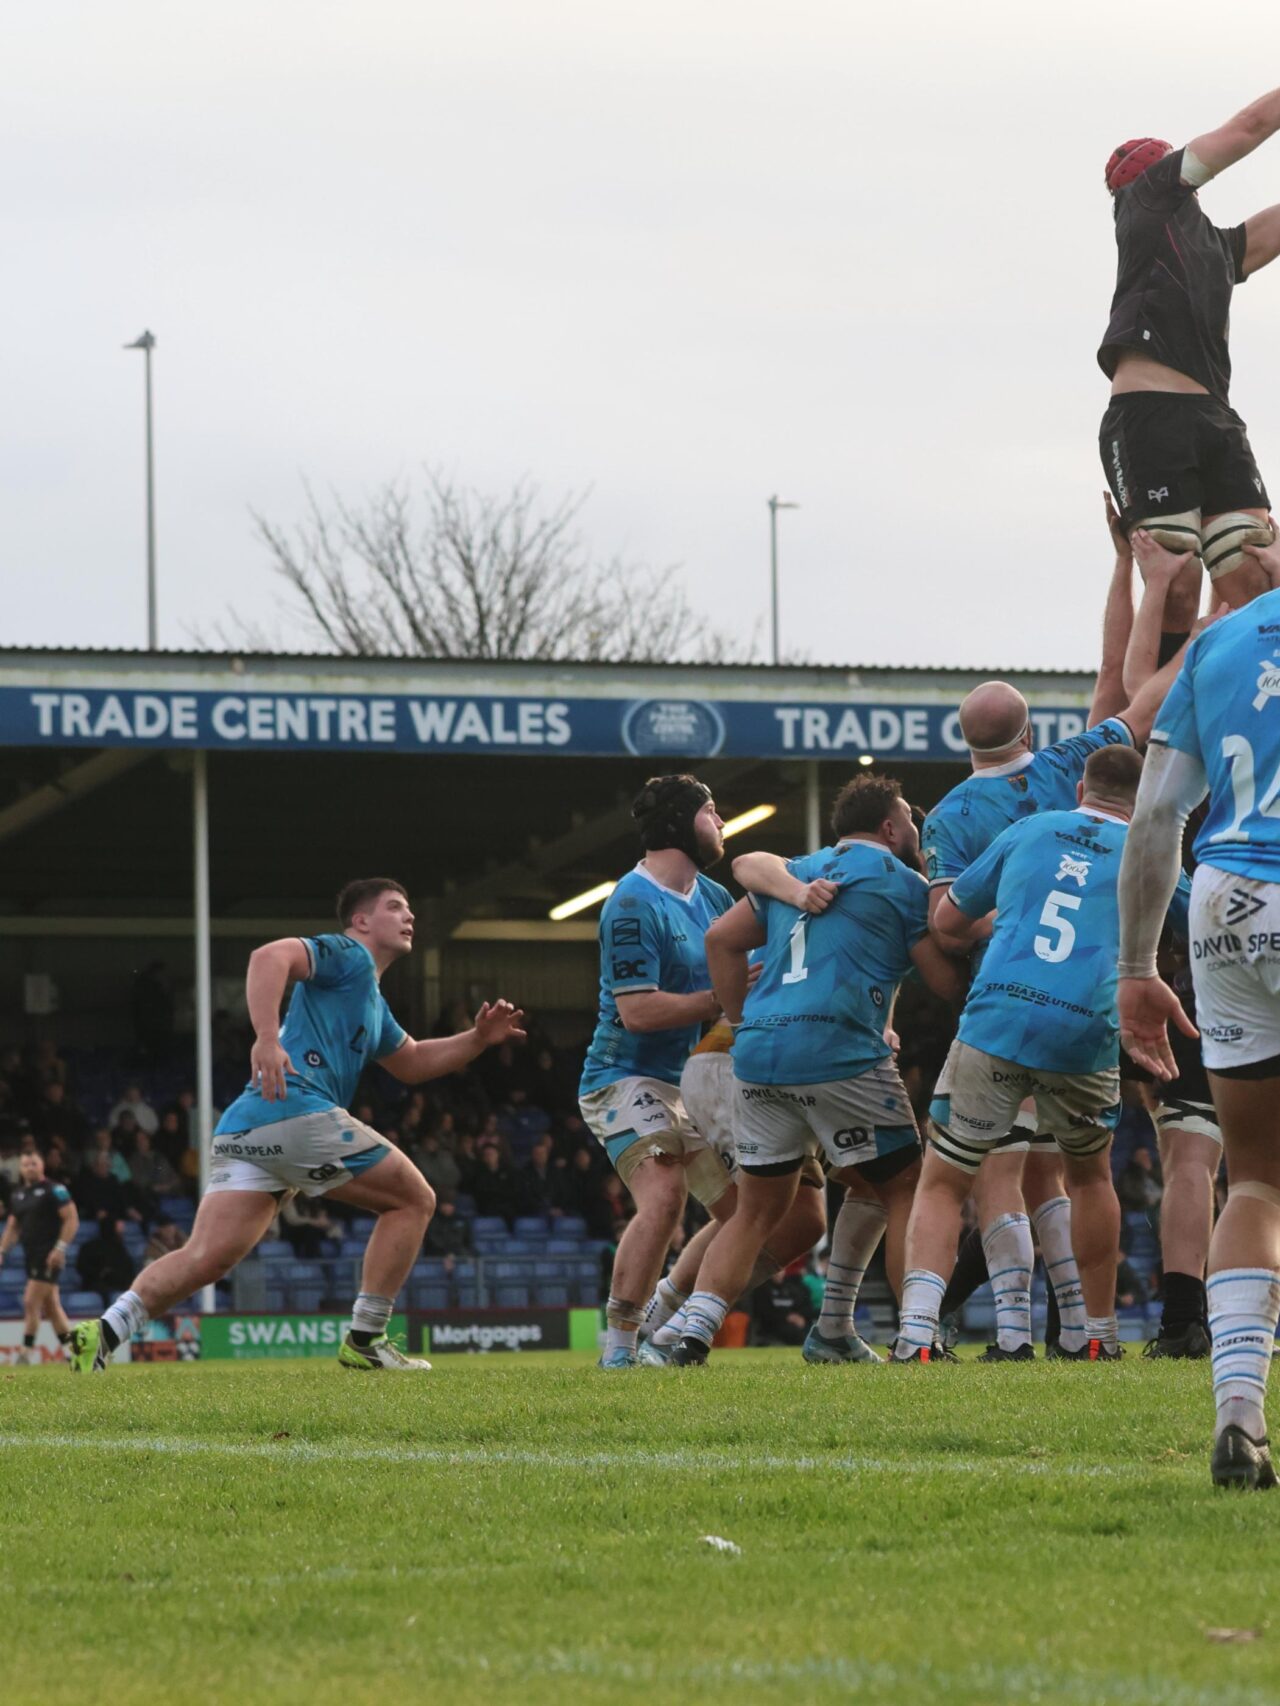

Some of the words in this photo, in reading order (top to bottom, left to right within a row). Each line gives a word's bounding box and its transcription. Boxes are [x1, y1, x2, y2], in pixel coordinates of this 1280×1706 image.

[30, 694, 198, 739] TRADE
[212, 697, 396, 741] CENTRE
[409, 700, 572, 745] WALES
[775, 708, 929, 751] TRADE
[1054, 831, 1114, 853] VALLEY
[1033, 889, 1081, 963] 5
[782, 911, 808, 985] 1
[1192, 933, 1242, 959] DAVID
[612, 955, 648, 980] iac
[833, 1126, 869, 1149] GD
[245, 1145, 284, 1157] SPEAR
[308, 1162, 338, 1182] GD
[432, 1324, 542, 1349] Mortgages
